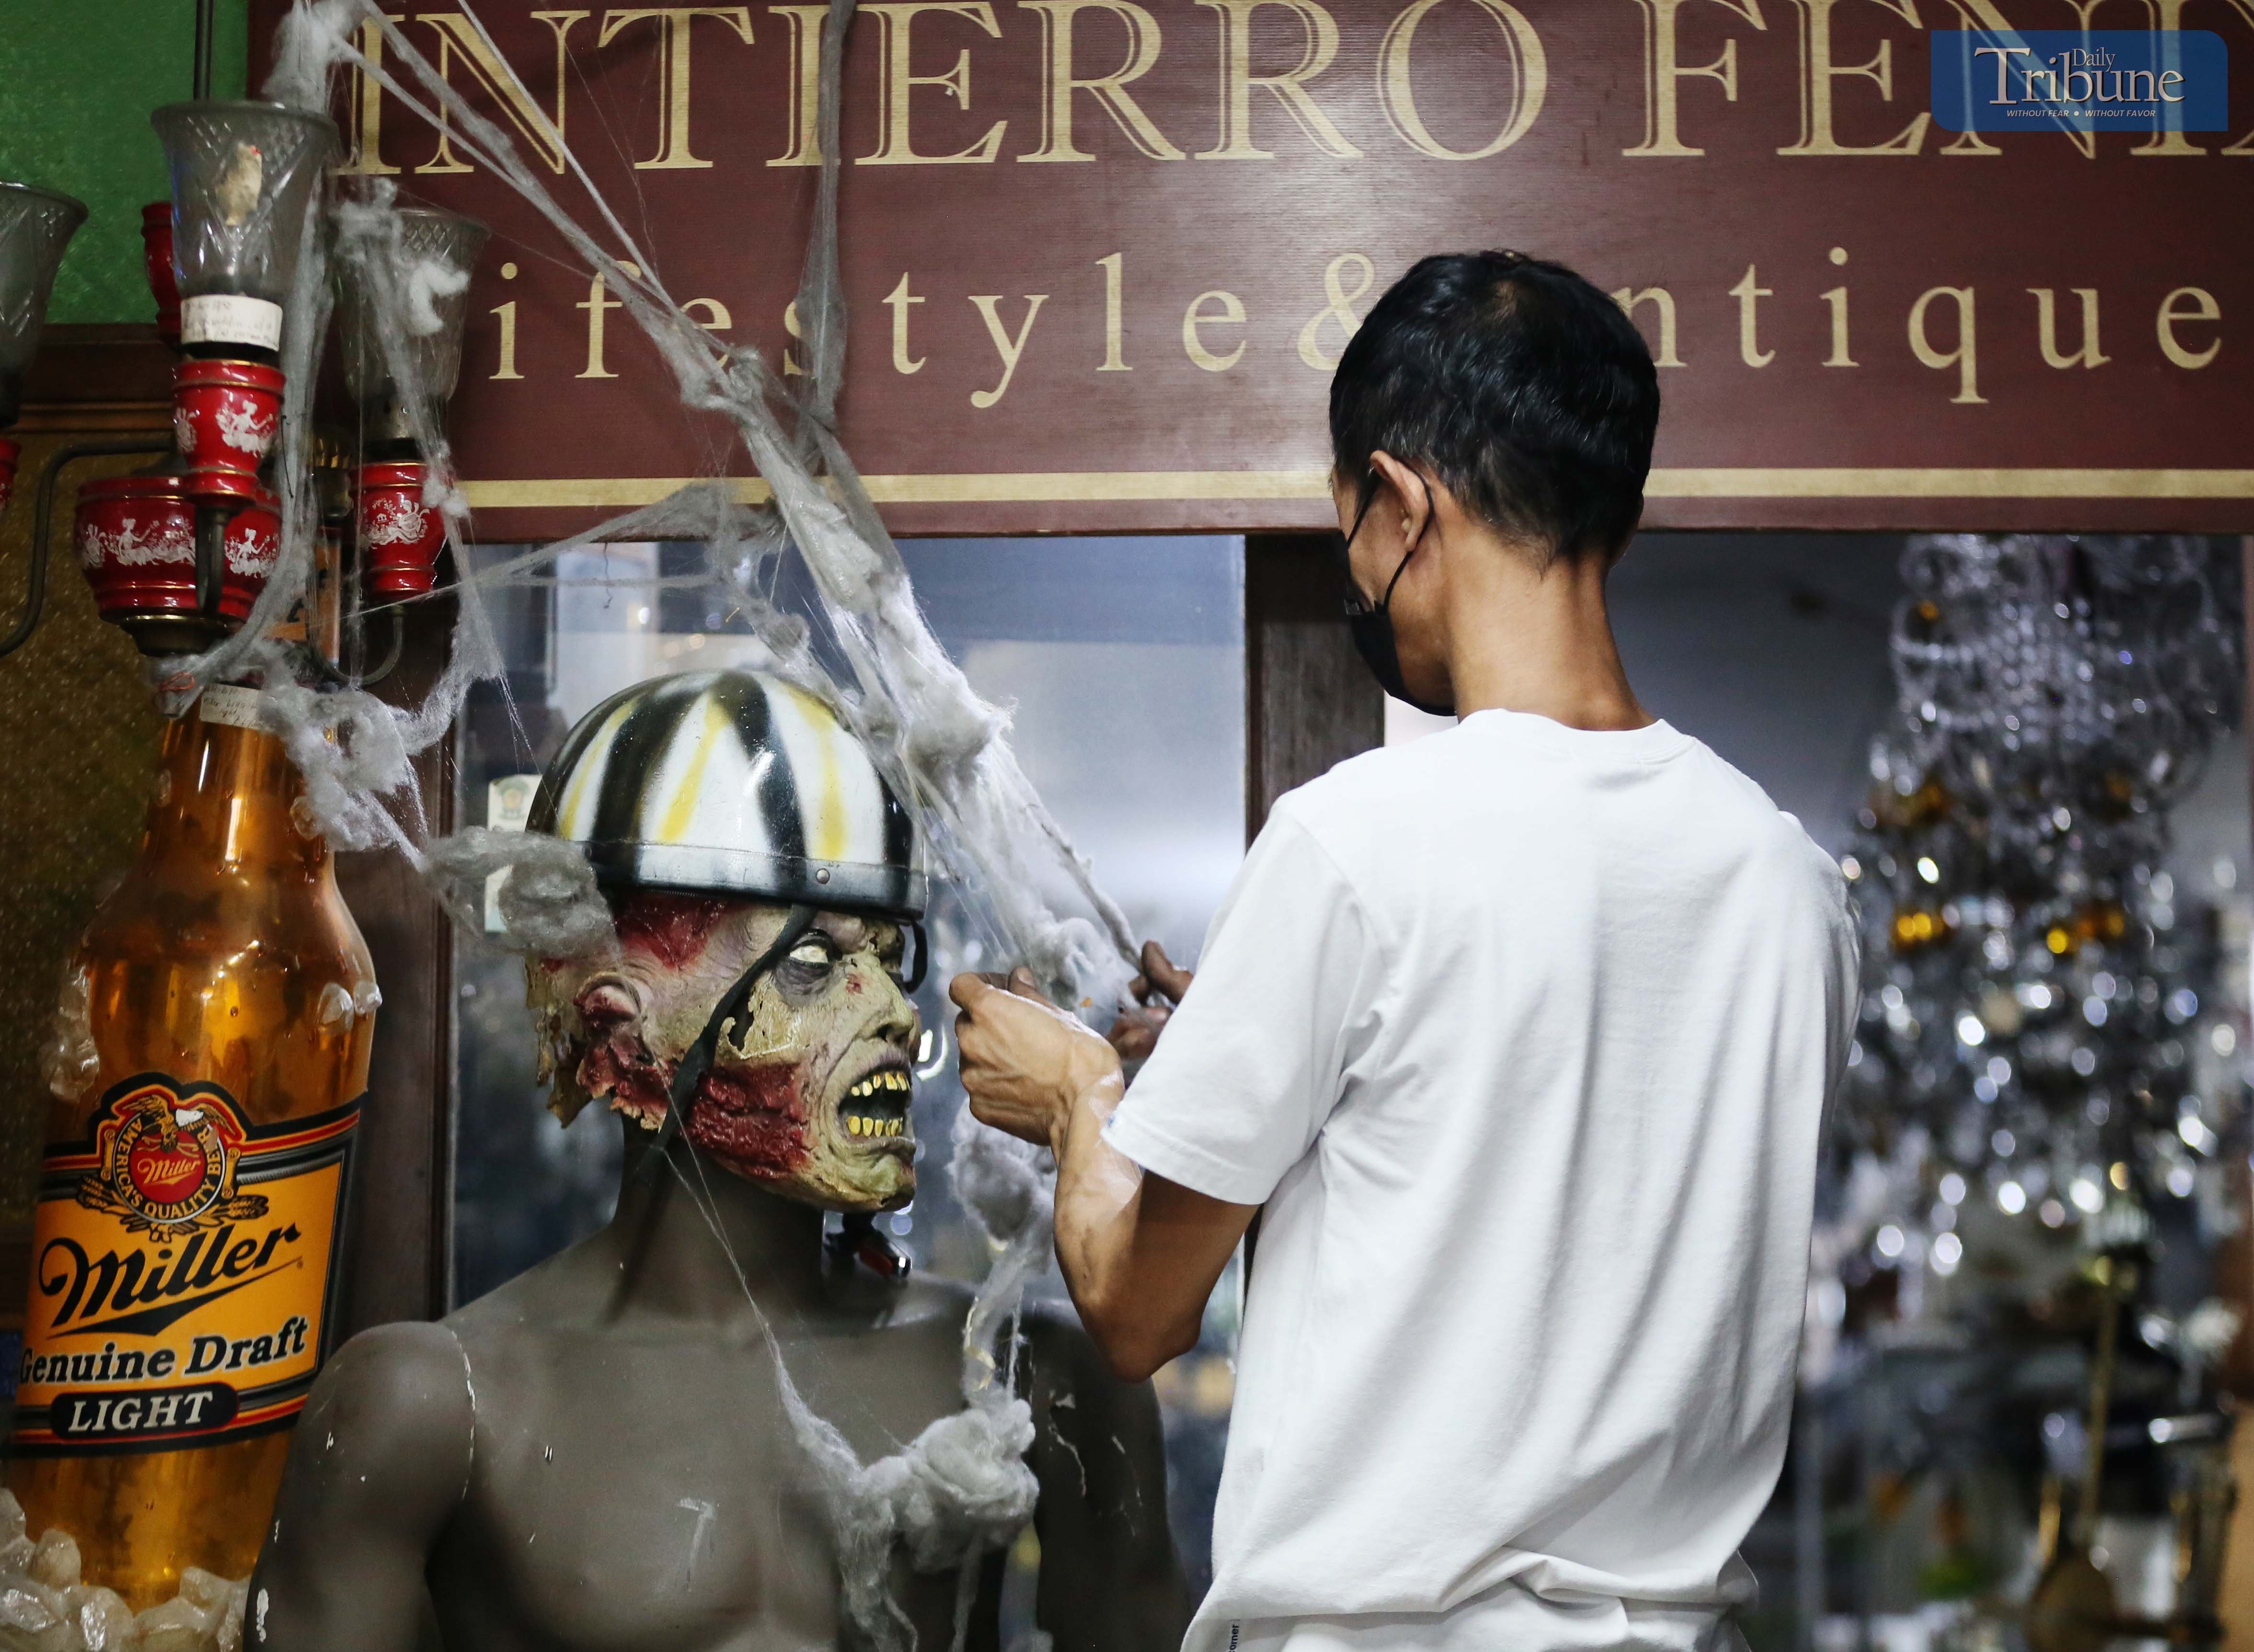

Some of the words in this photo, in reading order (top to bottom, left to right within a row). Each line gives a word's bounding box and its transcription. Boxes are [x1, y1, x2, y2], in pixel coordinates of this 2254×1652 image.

[328, 0, 1548, 175] INTIERRO
[1622, 0, 2254, 159] FENI
[1615, 246, 2222, 404] ntique
[116, 1118, 143, 1208] AMERICA'S
[144, 1177, 216, 1219] QUALITY
[197, 1126, 221, 1176] BER
[137, 1158, 202, 1184] Miller
[38, 1223, 302, 1328] Miller
[20, 1342, 175, 1384] Genuine
[184, 1316, 308, 1376] Draft
[68, 1390, 213, 1432] LIGHT
